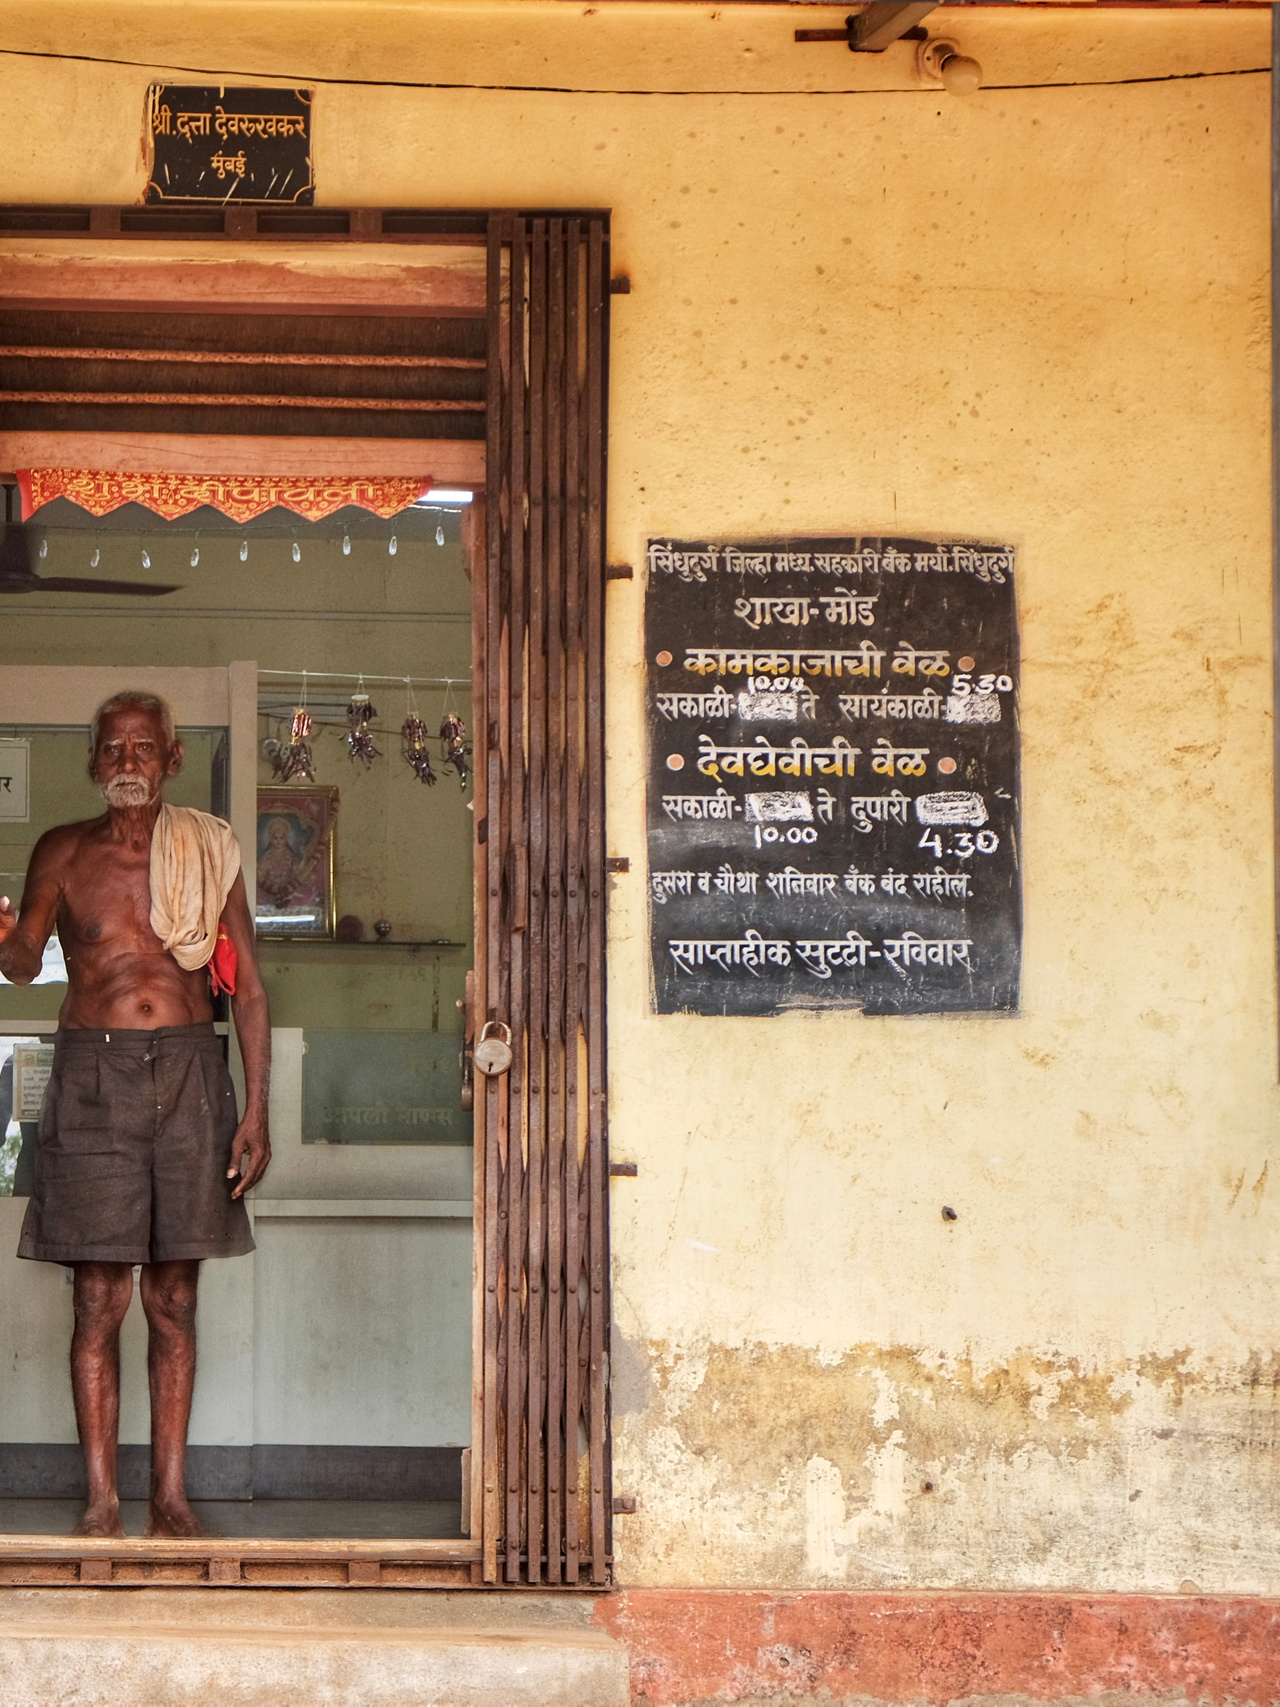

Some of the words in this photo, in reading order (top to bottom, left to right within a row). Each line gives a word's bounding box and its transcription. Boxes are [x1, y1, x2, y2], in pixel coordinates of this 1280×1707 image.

[177, 112, 212, 138] दत्ता
[210, 150, 247, 179] मुंबई
[647, 543, 720, 582] सिंधुदुर्ग
[722, 546, 773, 578] जिल्हा
[814, 548, 881, 577] सहकारी
[683, 639, 886, 678] कामकाजाची
[893, 640, 951, 677] वेळ
[871, 738, 930, 778] वेळ
[816, 787, 837, 825] ते
[851, 788, 912, 833] दुपारी
[754, 824, 819, 850] 10.00
[918, 827, 1001, 859] 4.30
[652, 870, 695, 905] दुसरा
[698, 871, 712, 895] व
[713, 863, 760, 900] चौथा
[765, 866, 839, 900] शनिवार
[881, 867, 912, 899] बंद
[669, 929, 791, 978] साप्ताहीक
